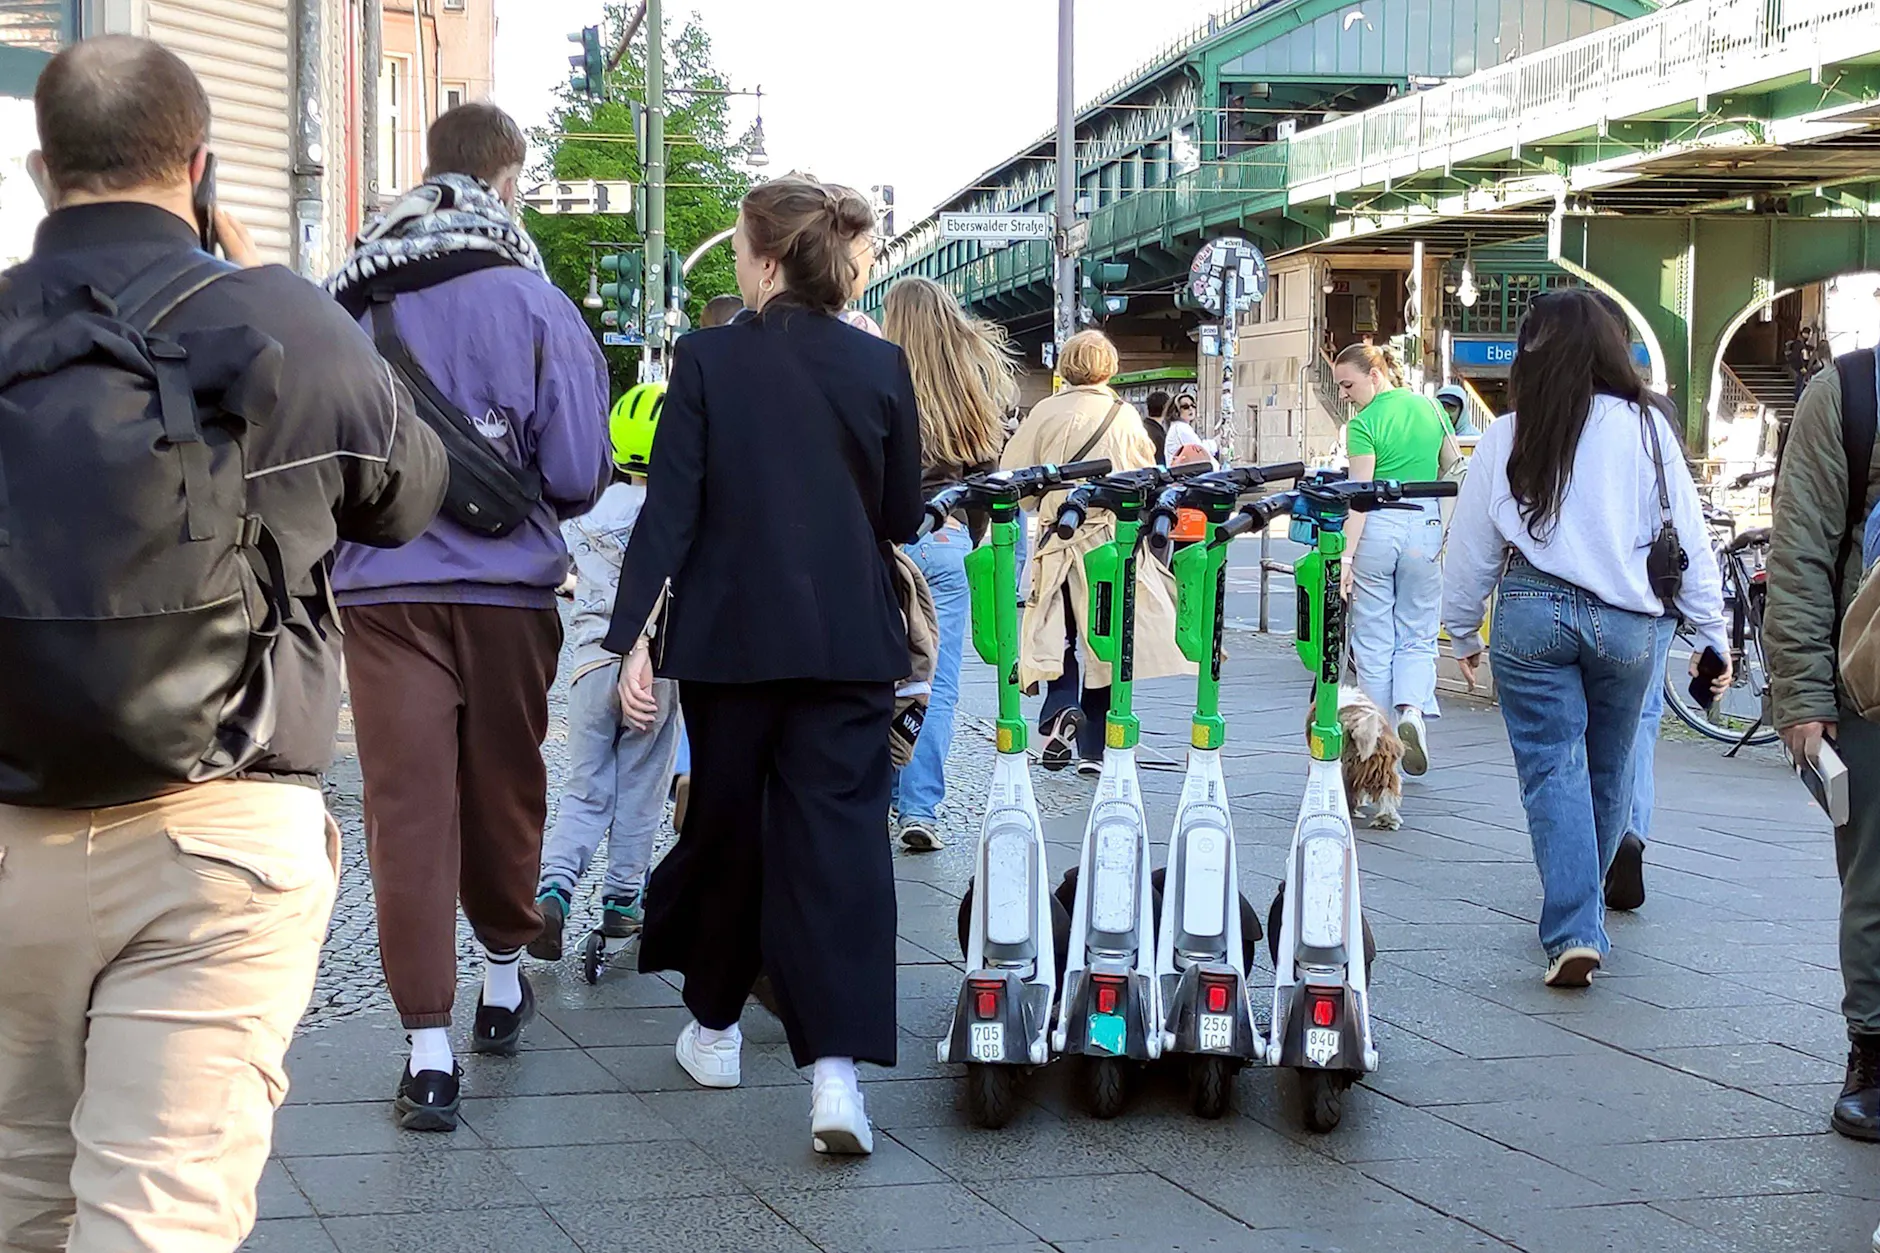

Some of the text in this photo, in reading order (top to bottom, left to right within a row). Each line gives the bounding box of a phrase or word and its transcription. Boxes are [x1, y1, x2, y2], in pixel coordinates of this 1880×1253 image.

[947, 219, 1044, 235] Eberswalder Straße
[1203, 1016, 1228, 1032] 256
[974, 1026, 999, 1041] 705
[1310, 1031, 1335, 1047] 840
